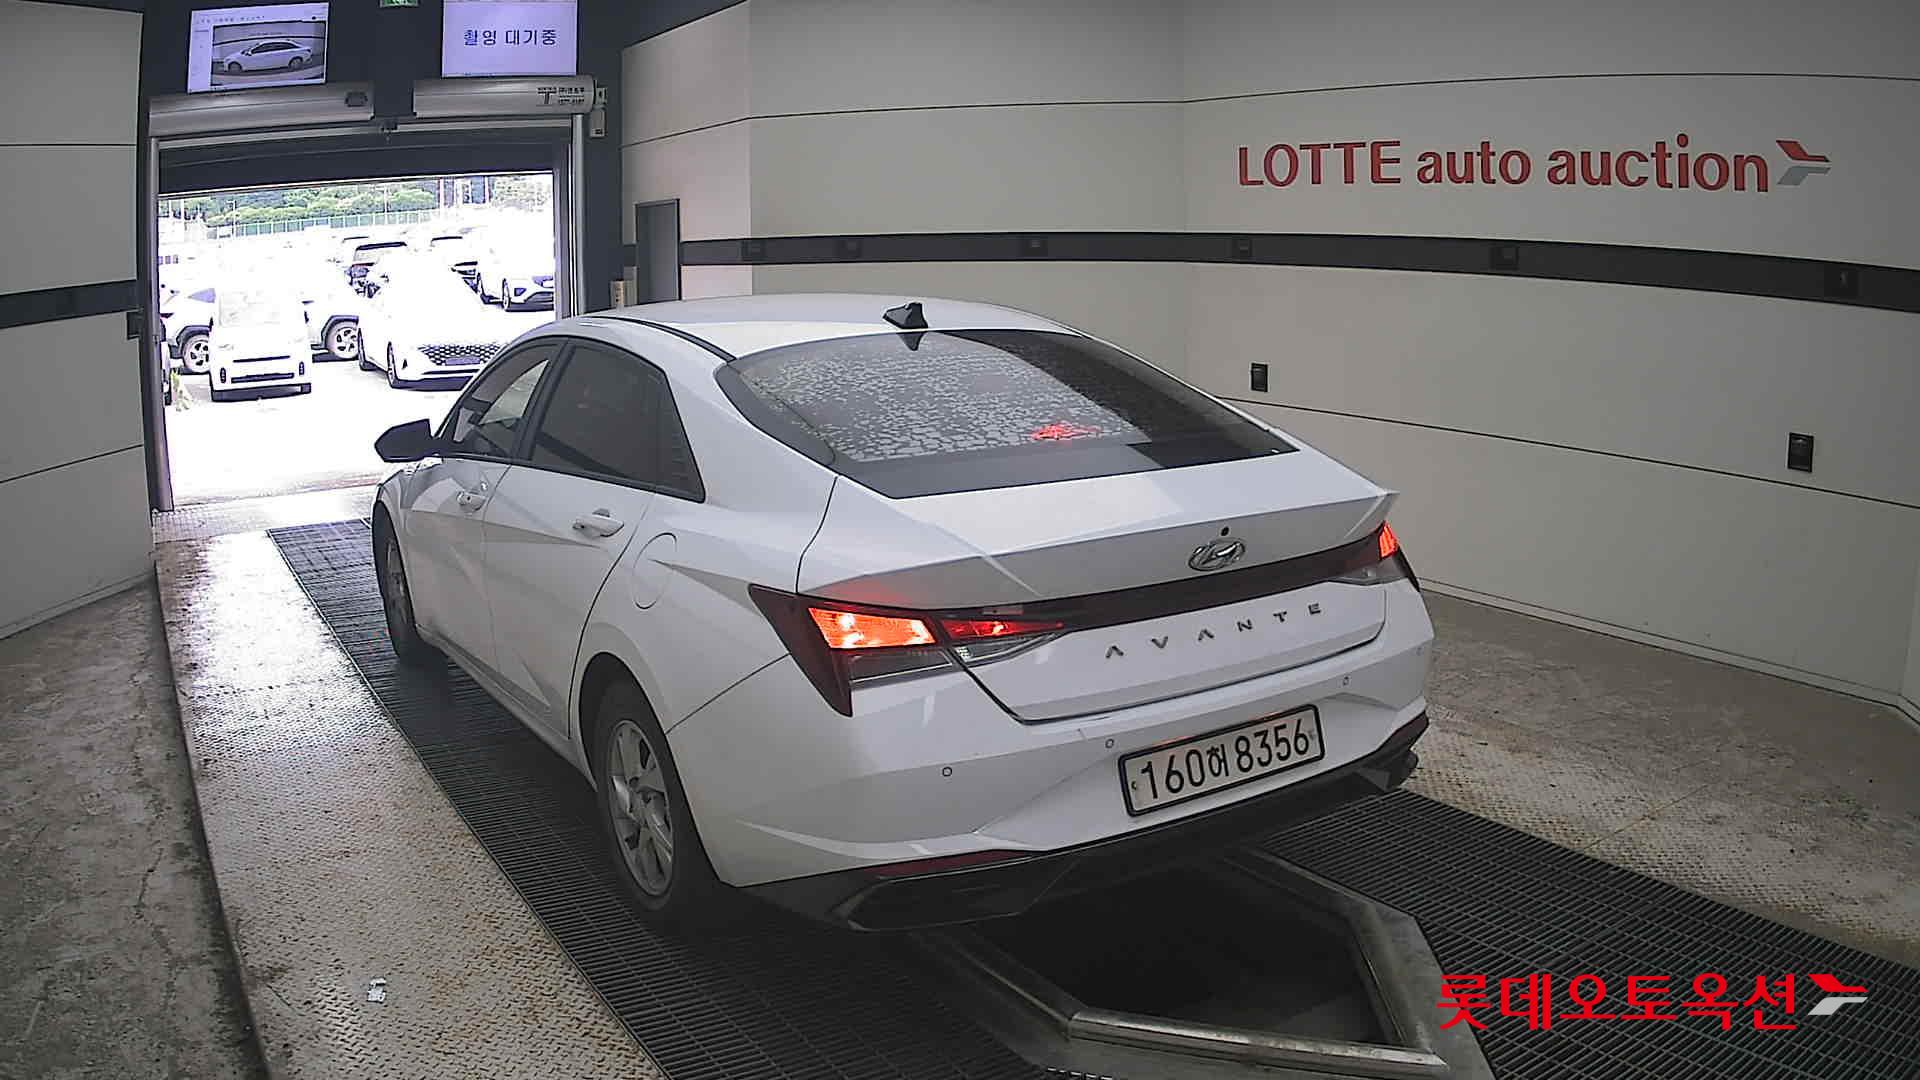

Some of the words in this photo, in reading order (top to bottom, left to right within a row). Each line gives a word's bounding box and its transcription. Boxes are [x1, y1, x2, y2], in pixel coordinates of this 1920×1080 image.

[505, 29, 557, 46] 대기중
[1238, 140, 1400, 187] LOTTE
[1416, 141, 1531, 185] auto
[1547, 133, 1769, 192] auction
[1105, 603, 1322, 659] AVANTE
